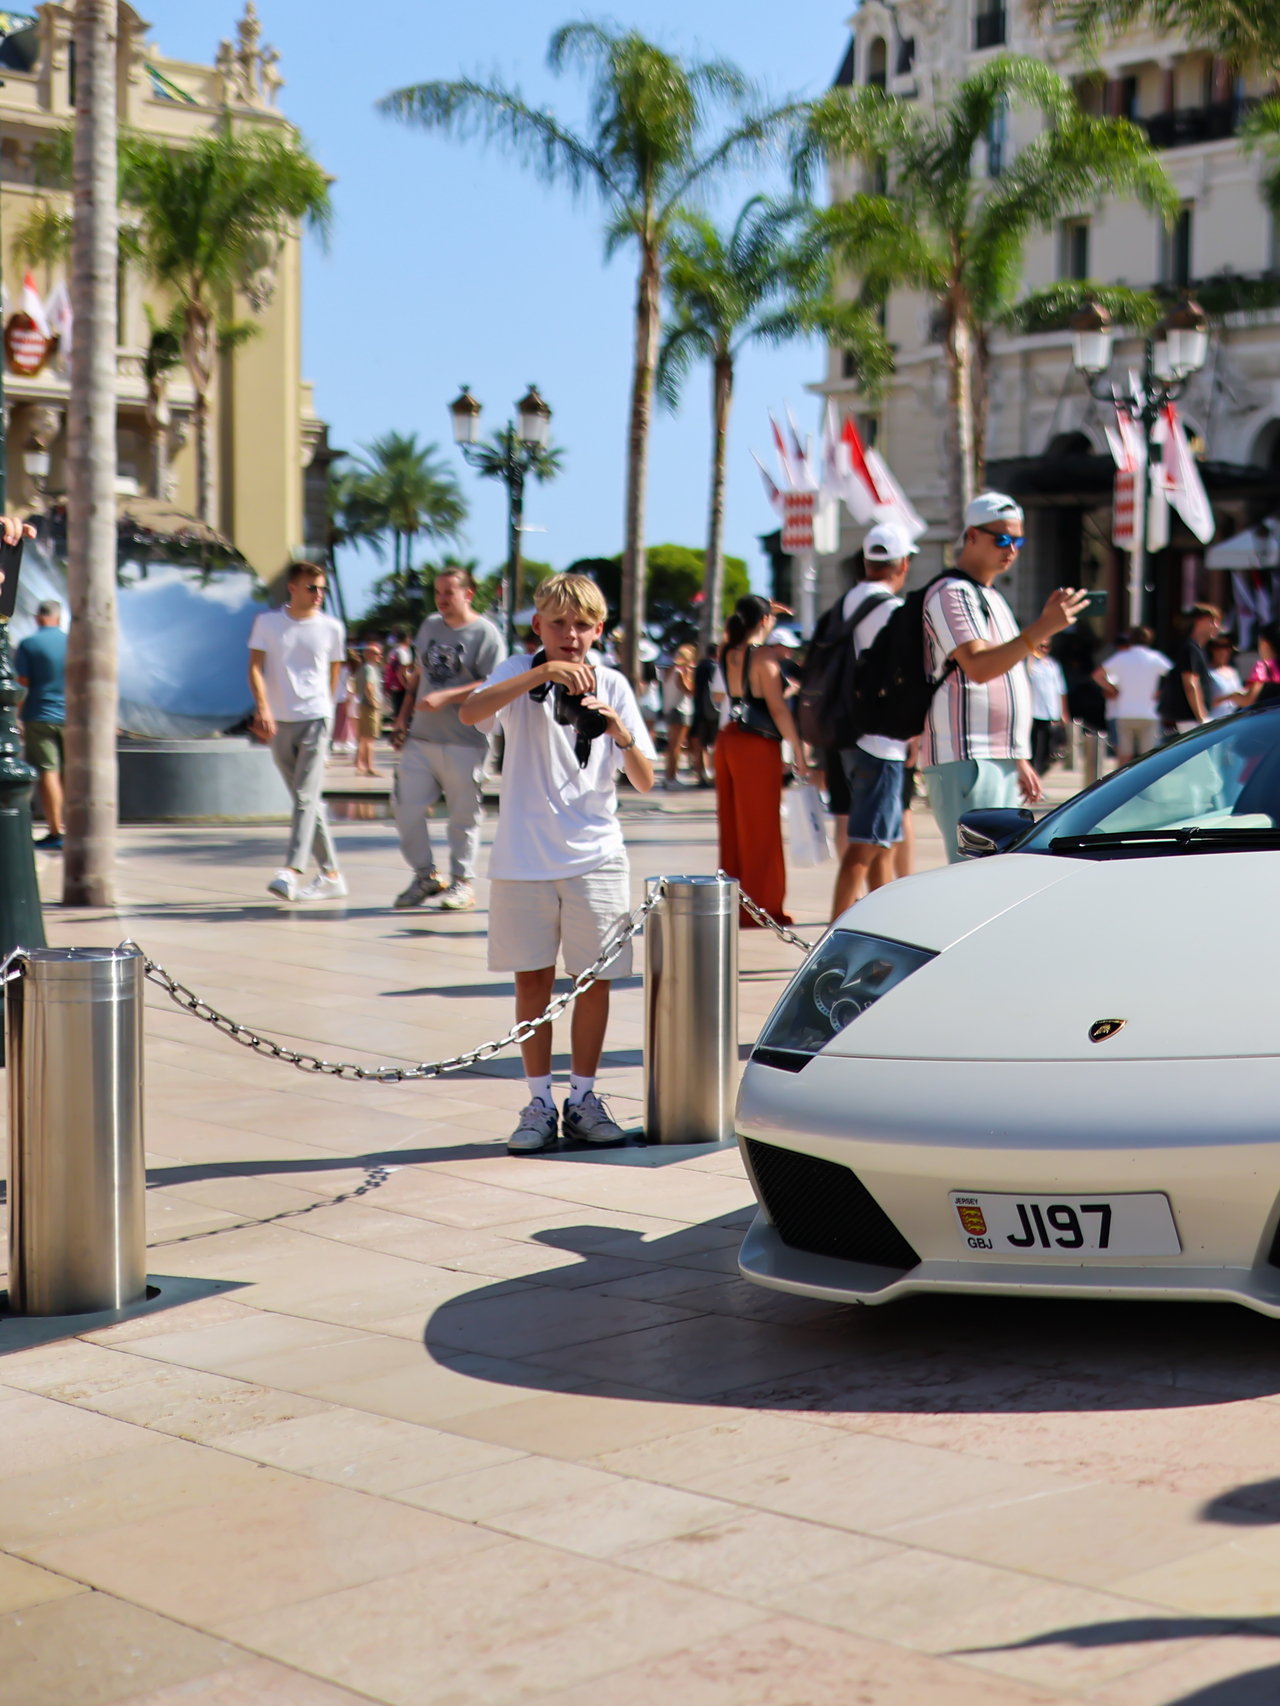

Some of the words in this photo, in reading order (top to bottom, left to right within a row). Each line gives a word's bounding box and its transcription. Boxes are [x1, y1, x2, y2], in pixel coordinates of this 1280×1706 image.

[954, 1197, 979, 1206] JERSEY
[1006, 1203, 1113, 1250] J197
[966, 1236, 994, 1250] GBJ
